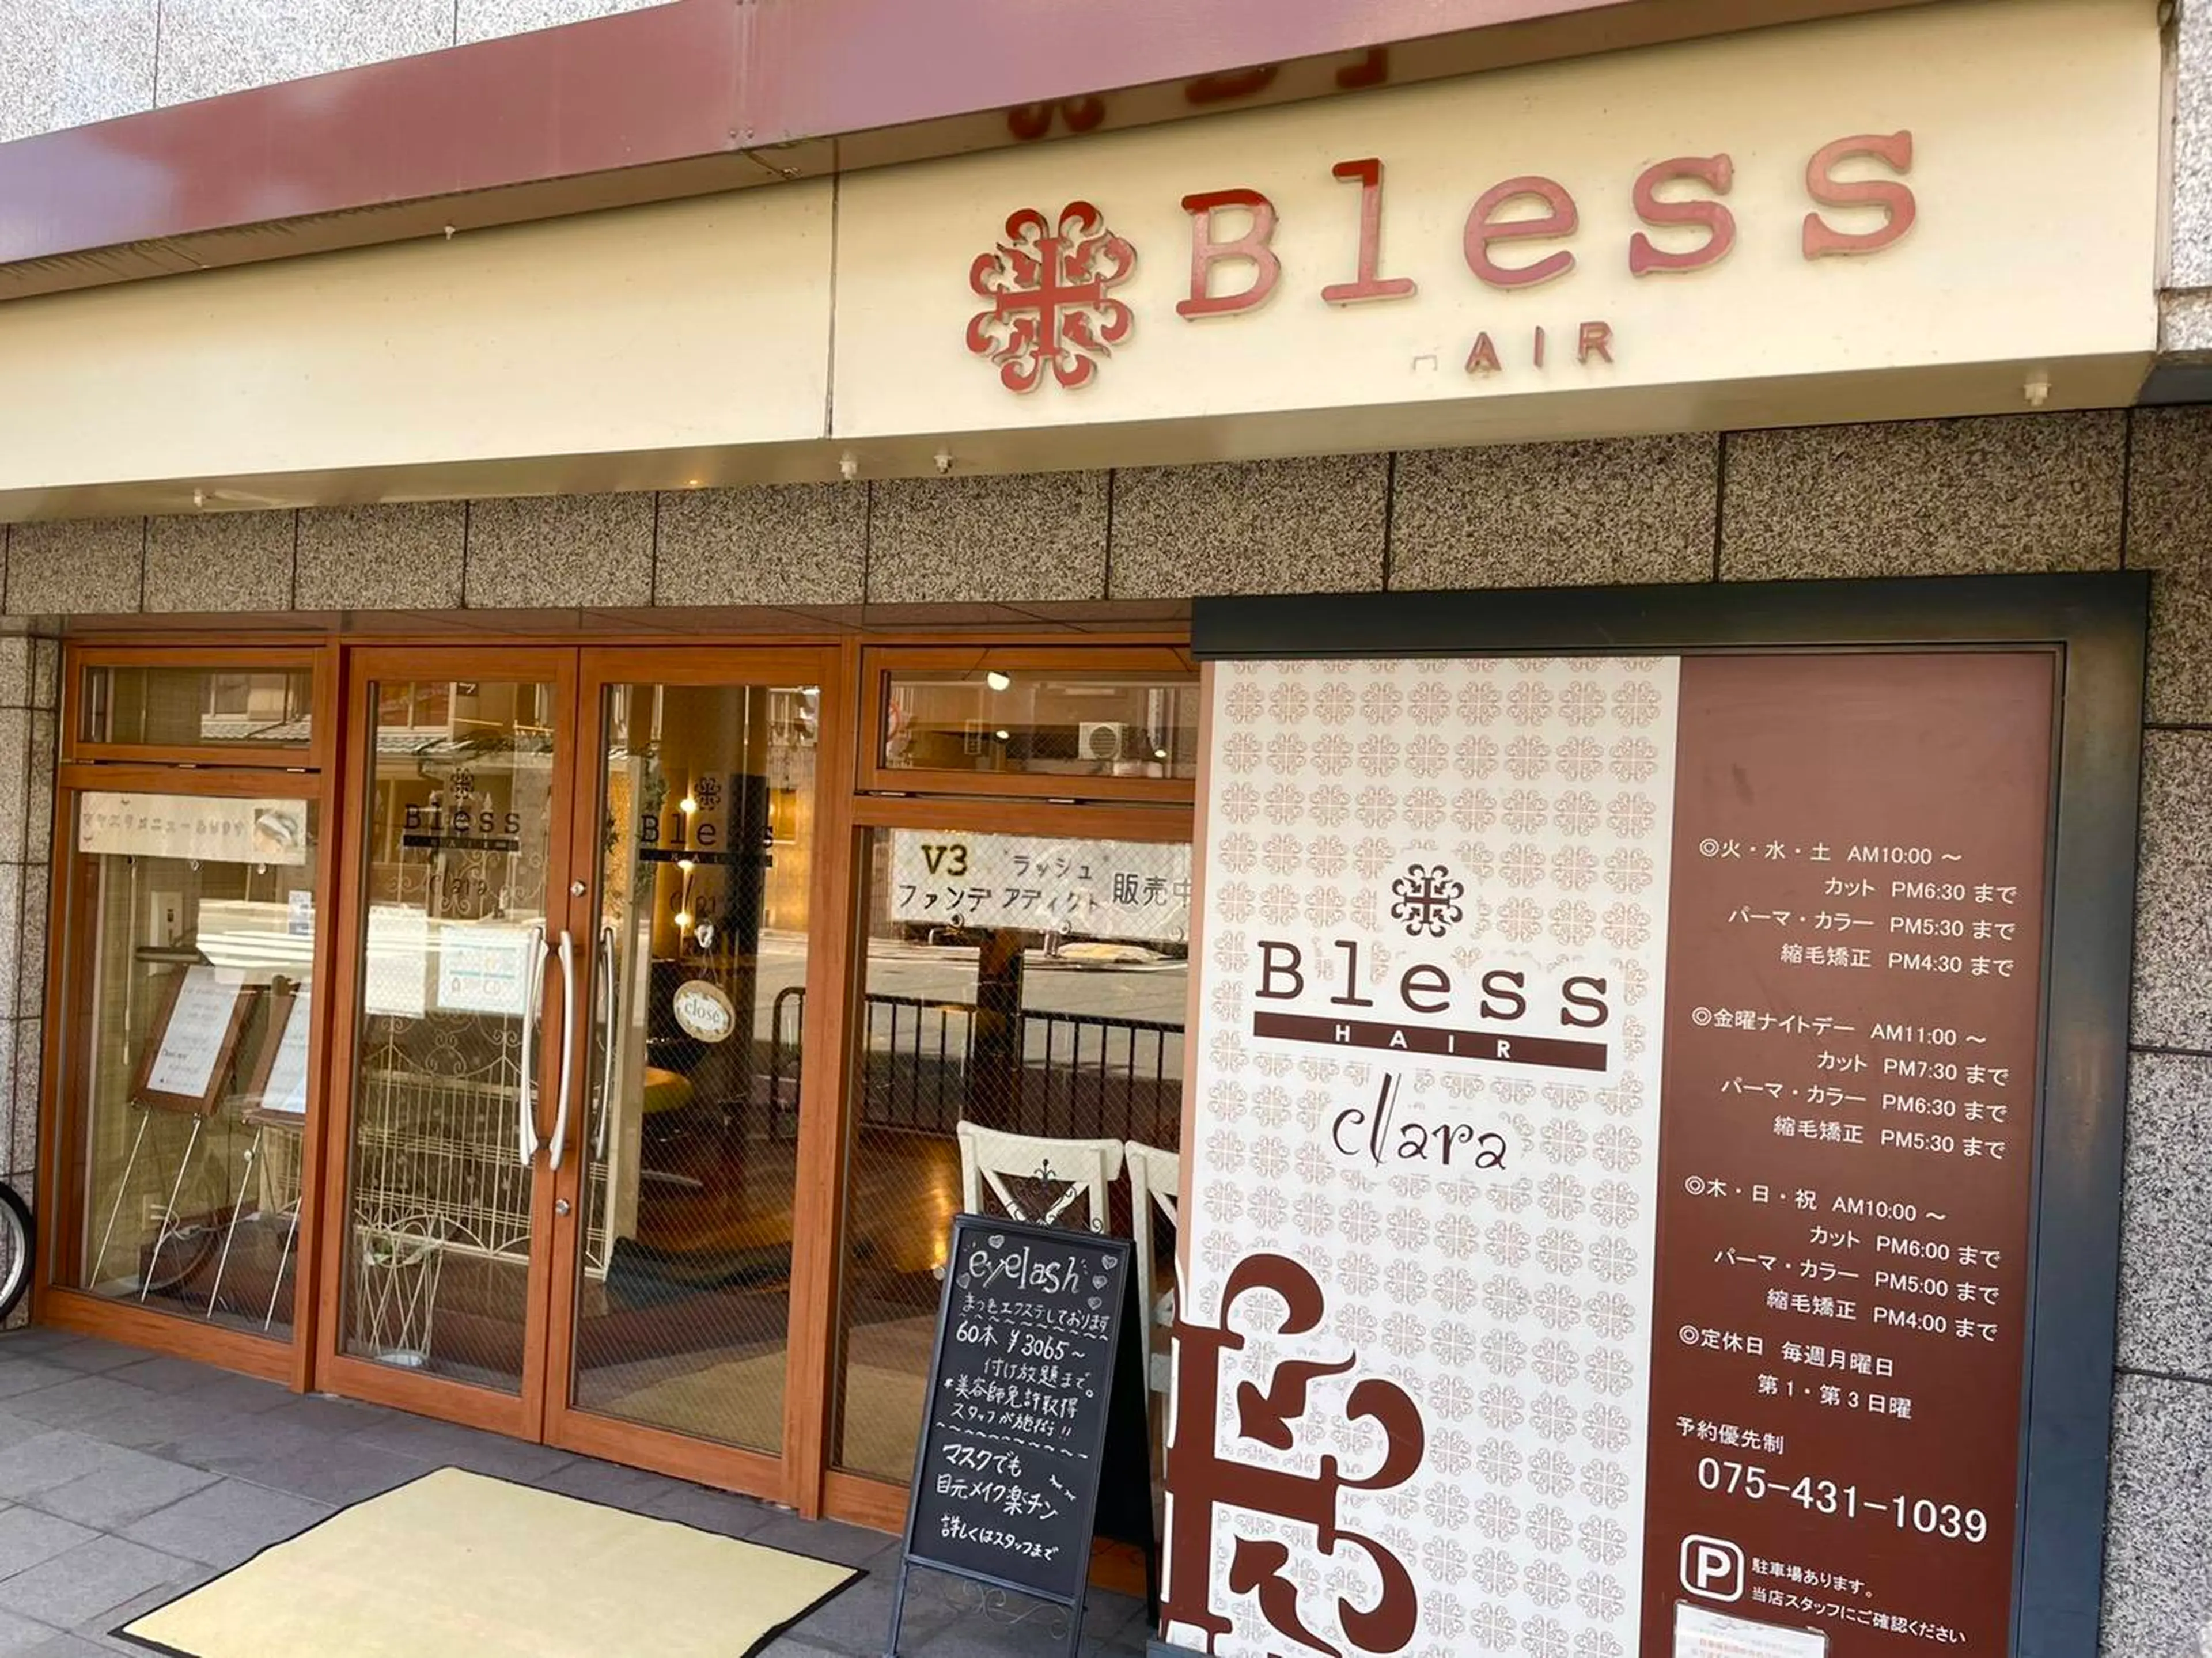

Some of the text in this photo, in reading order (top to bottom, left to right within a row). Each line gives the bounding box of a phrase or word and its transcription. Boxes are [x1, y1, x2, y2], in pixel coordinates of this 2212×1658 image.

[1175, 130, 1919, 319] Bless
[404, 801, 520, 833] Bless
[641, 813, 773, 849] Bles
[921, 844, 968, 876] V3
[1013, 854, 1093, 881] ラッシュ
[1847, 844, 1932, 865] AM10:00
[1824, 876, 2017, 905] カット PM6:30 まで
[1728, 905, 2015, 941] パーマ・カラー PM5:30 まで
[1780, 942, 2014, 978] 縮毛矯正 PM4:30 まで
[1254, 939, 1609, 1028] Bless
[685, 998, 720, 1023] close
[1335, 1025, 1511, 1059] HAIR
[1870, 1023, 1957, 1045] AM11:00
[1817, 1050, 2009, 1086] カット PM7:30 まで
[1721, 1076, 2008, 1123] パーマ・カラー PM6:30 まで
[1332, 1072, 1507, 1170] clara
[1772, 1115, 2006, 1159] 縮毛矯正 PM5:30 まで
[1831, 1196, 1917, 1221] AM10:00
[1810, 1226, 2001, 1269] カット PM6:00 まで
[969, 1247, 1080, 1293] eyelash
[1714, 1248, 1999, 1305] パーマ・カラー PM5:00 まで
[1766, 1288, 1998, 1342] 縮毛矯正 PM4:00 まで
[956, 1321, 998, 1348] 60本
[1781, 1341, 1894, 1378] 毎週月曜日
[1676, 1416, 1785, 1455] 予約優先制
[942, 1444, 1022, 1477] マスクでも
[936, 1473, 1059, 1520] 目元メイク楽チン
[940, 1515, 1059, 1561] 詳しくはスタッフまで
[1752, 1557, 1873, 1598] 駐車場あります。
[1752, 1585, 1967, 1645] 当店スタッフにご確認ください
